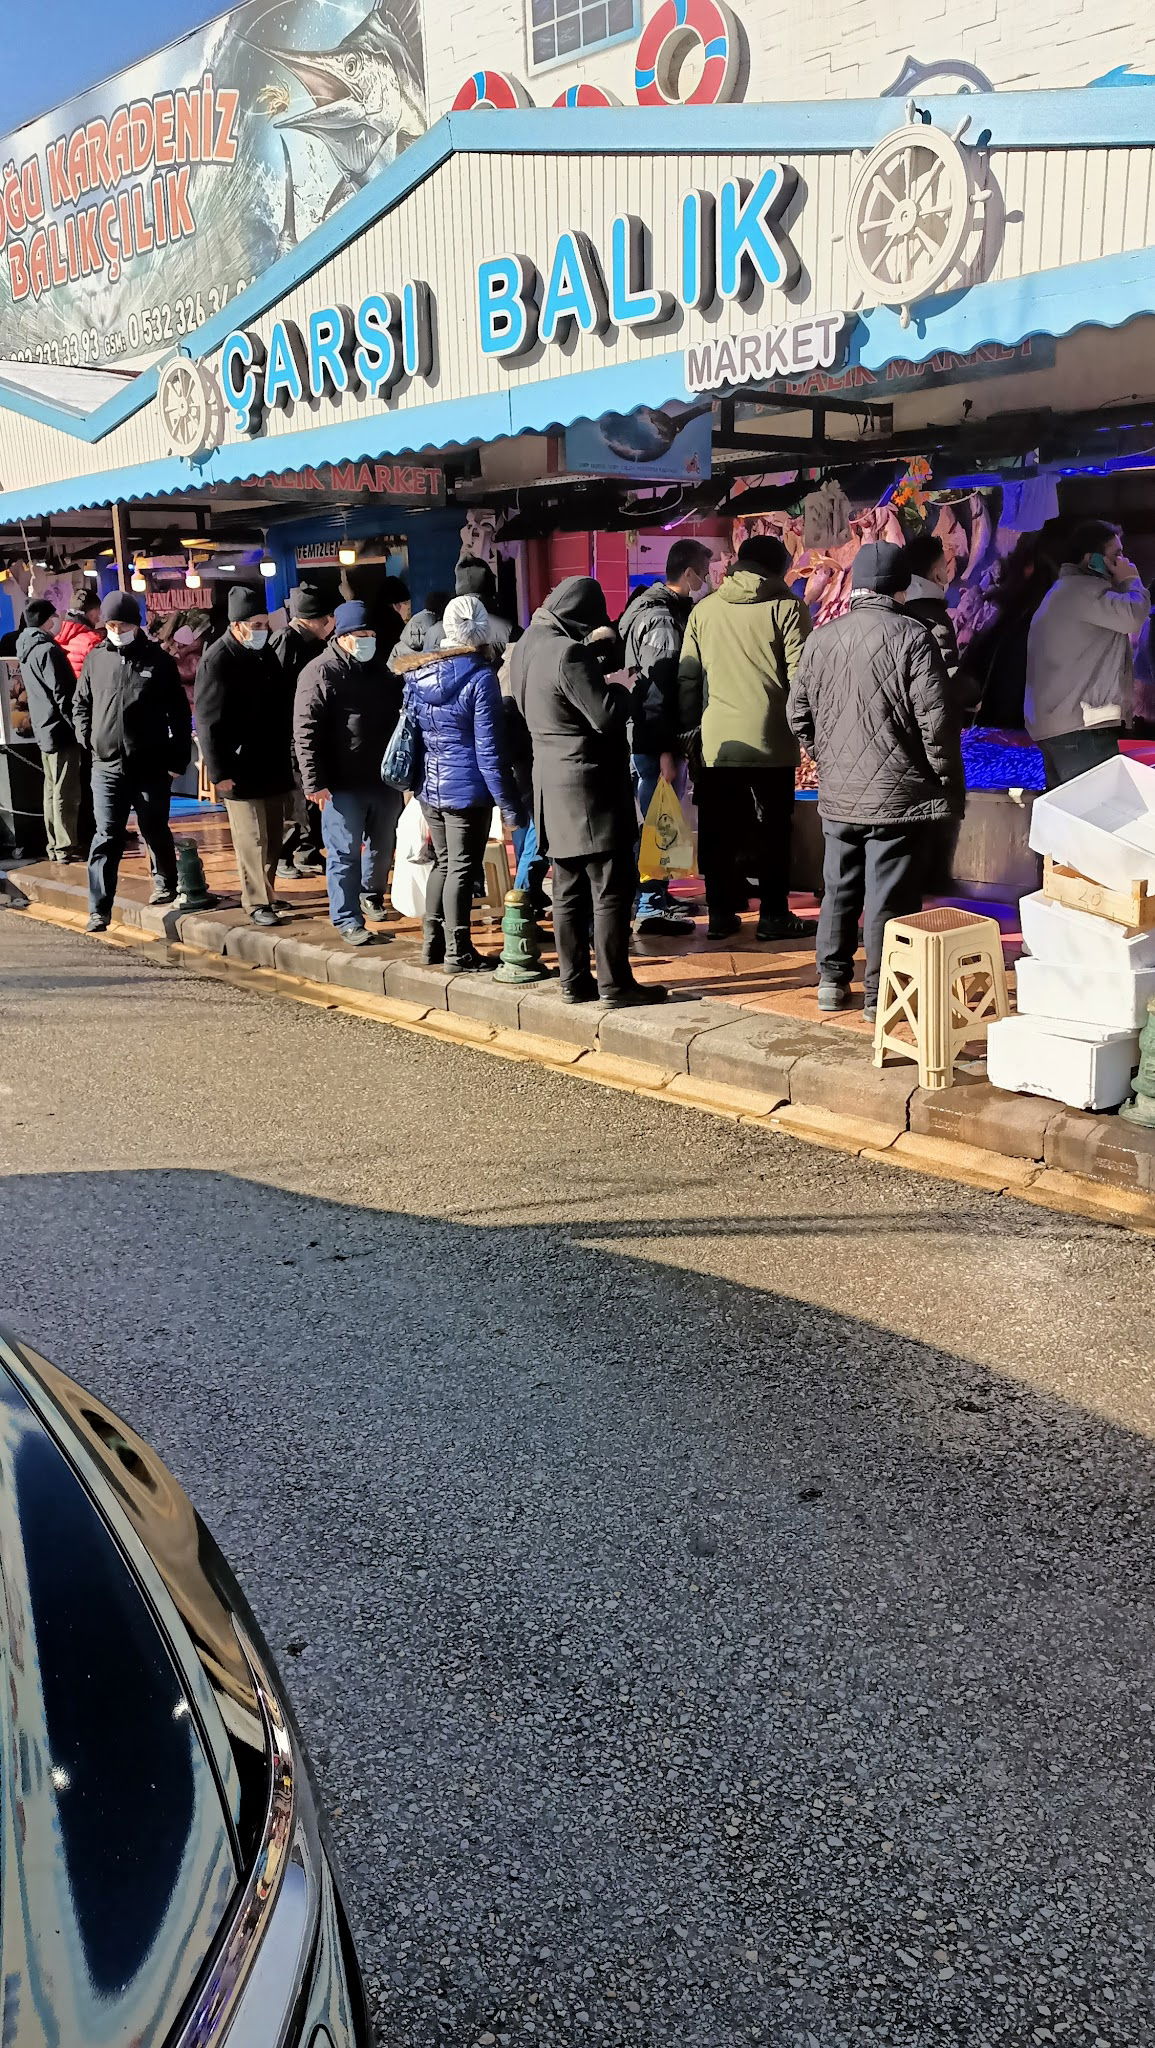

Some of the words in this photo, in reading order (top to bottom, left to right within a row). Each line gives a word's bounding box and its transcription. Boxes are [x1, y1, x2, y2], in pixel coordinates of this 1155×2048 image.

[46, 72, 240, 209] KARADENİZ
[7, 166, 196, 302] BALIKÇILIK
[62, 333, 80, 366] 33
[81, 327, 100, 363] 93
[104, 331, 127, 356] GSM:
[127, 312, 139, 349] 0
[142, 303, 173, 345] 532
[174, 292, 206, 336] 326
[220, 279, 424, 431] ÇARŞI
[477, 163, 795, 360] BALIK
[686, 312, 844, 392] MARKET
[330, 463, 442, 495] MARKET
